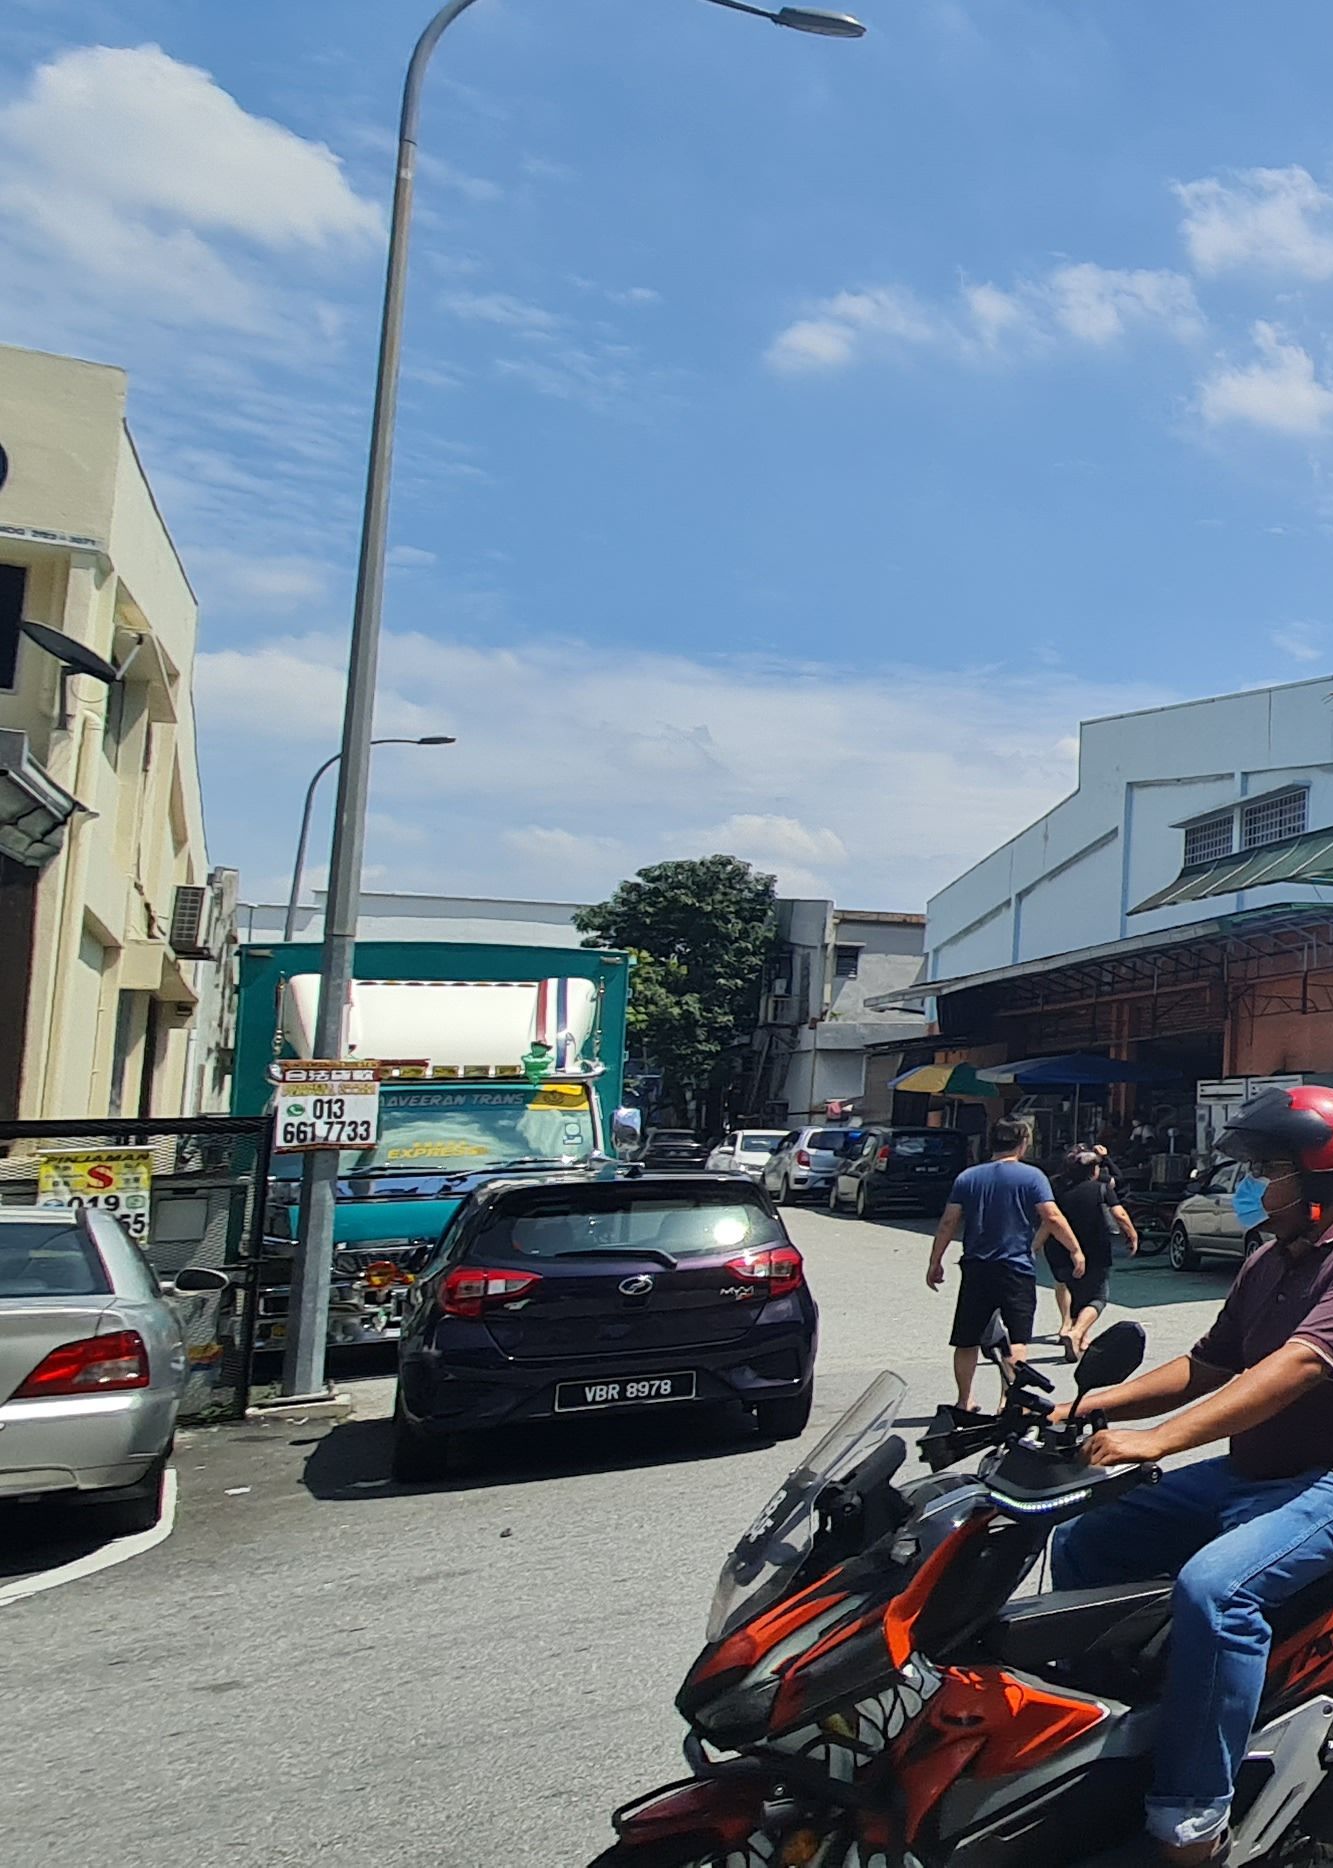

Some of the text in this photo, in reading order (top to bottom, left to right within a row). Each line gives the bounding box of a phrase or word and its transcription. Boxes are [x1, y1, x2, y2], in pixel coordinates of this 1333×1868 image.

[313, 1099, 345, 1120] 013
[472, 1092, 525, 1106] TRANS
[283, 1121, 371, 1143] 661 7733
[585, 1379, 672, 1402] VBR 8978
